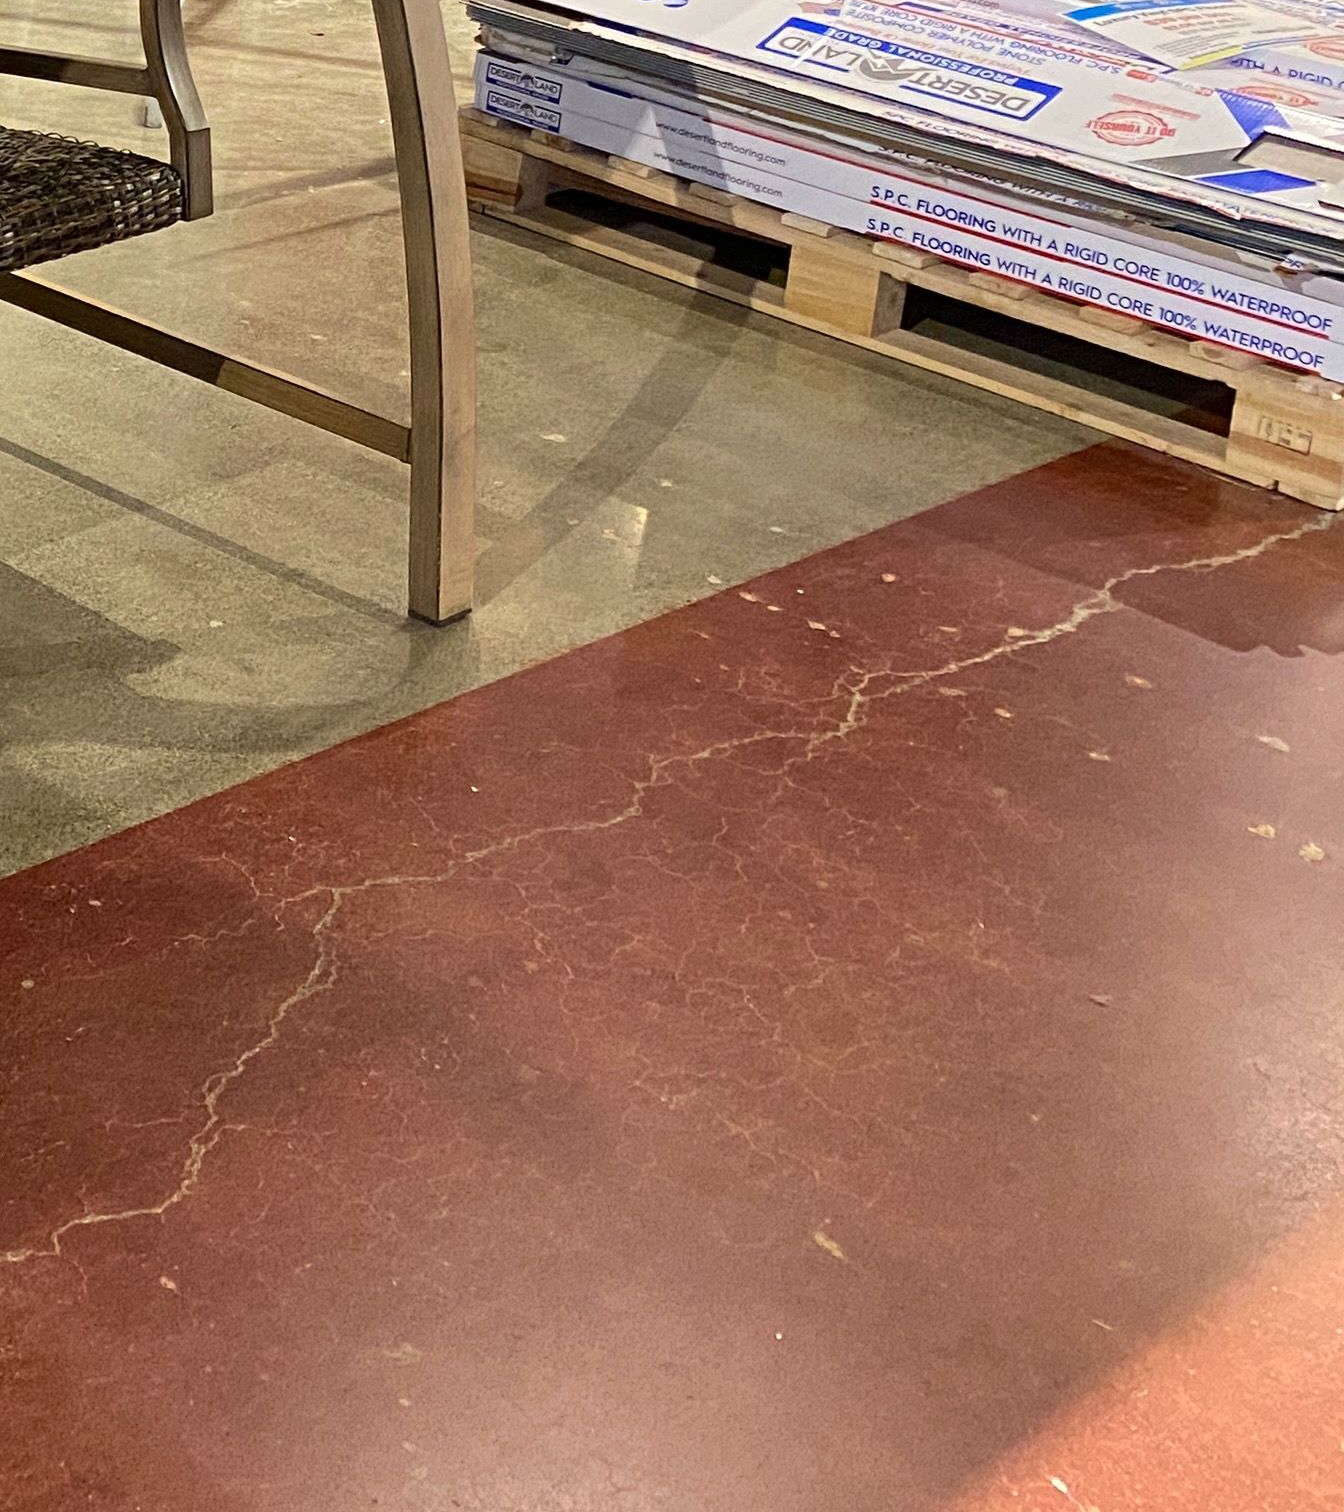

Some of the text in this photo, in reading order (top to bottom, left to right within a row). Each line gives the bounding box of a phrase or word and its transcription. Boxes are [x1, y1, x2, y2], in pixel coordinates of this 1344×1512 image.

[881, 8, 918, 22] CORE
[920, 18, 958, 32] RIGID
[845, 9, 1046, 66] STONE POLYMER COMPOSITE
[959, 25, 971, 34] A
[969, 30, 1006, 45] WITH
[826, 27, 1018, 86] PROFESSIONAL GRADE
[1009, 41, 1082, 65] FLOORING
[490, 66, 521, 85] DESERT
[534, 81, 558, 95] LAND
[778, 35, 1031, 113] DESERT LAND
[490, 95, 521, 111] DESERT
[534, 109, 558, 123] LAND
[1086, 118, 1142, 134] YOURSELF
[1145, 126, 1157, 136] IT
[655, 122, 787, 168] www.desertlandflooring.com
[652, 151, 784, 198] www.desertlandflooring.com
[871, 185, 1334, 332] S.P.C. FLOORING WITH A RIGID CORE 100% WATERPROOF
[912, 231, 992, 266] FLOORING
[996, 256, 1038, 281] WITH
[1041, 273, 1053, 286] A
[1058, 276, 1103, 300] RIGID
[1107, 292, 1154, 317] CORE
[1159, 306, 1197, 331] 100%
[1203, 320, 1326, 369] WATERPROOF
